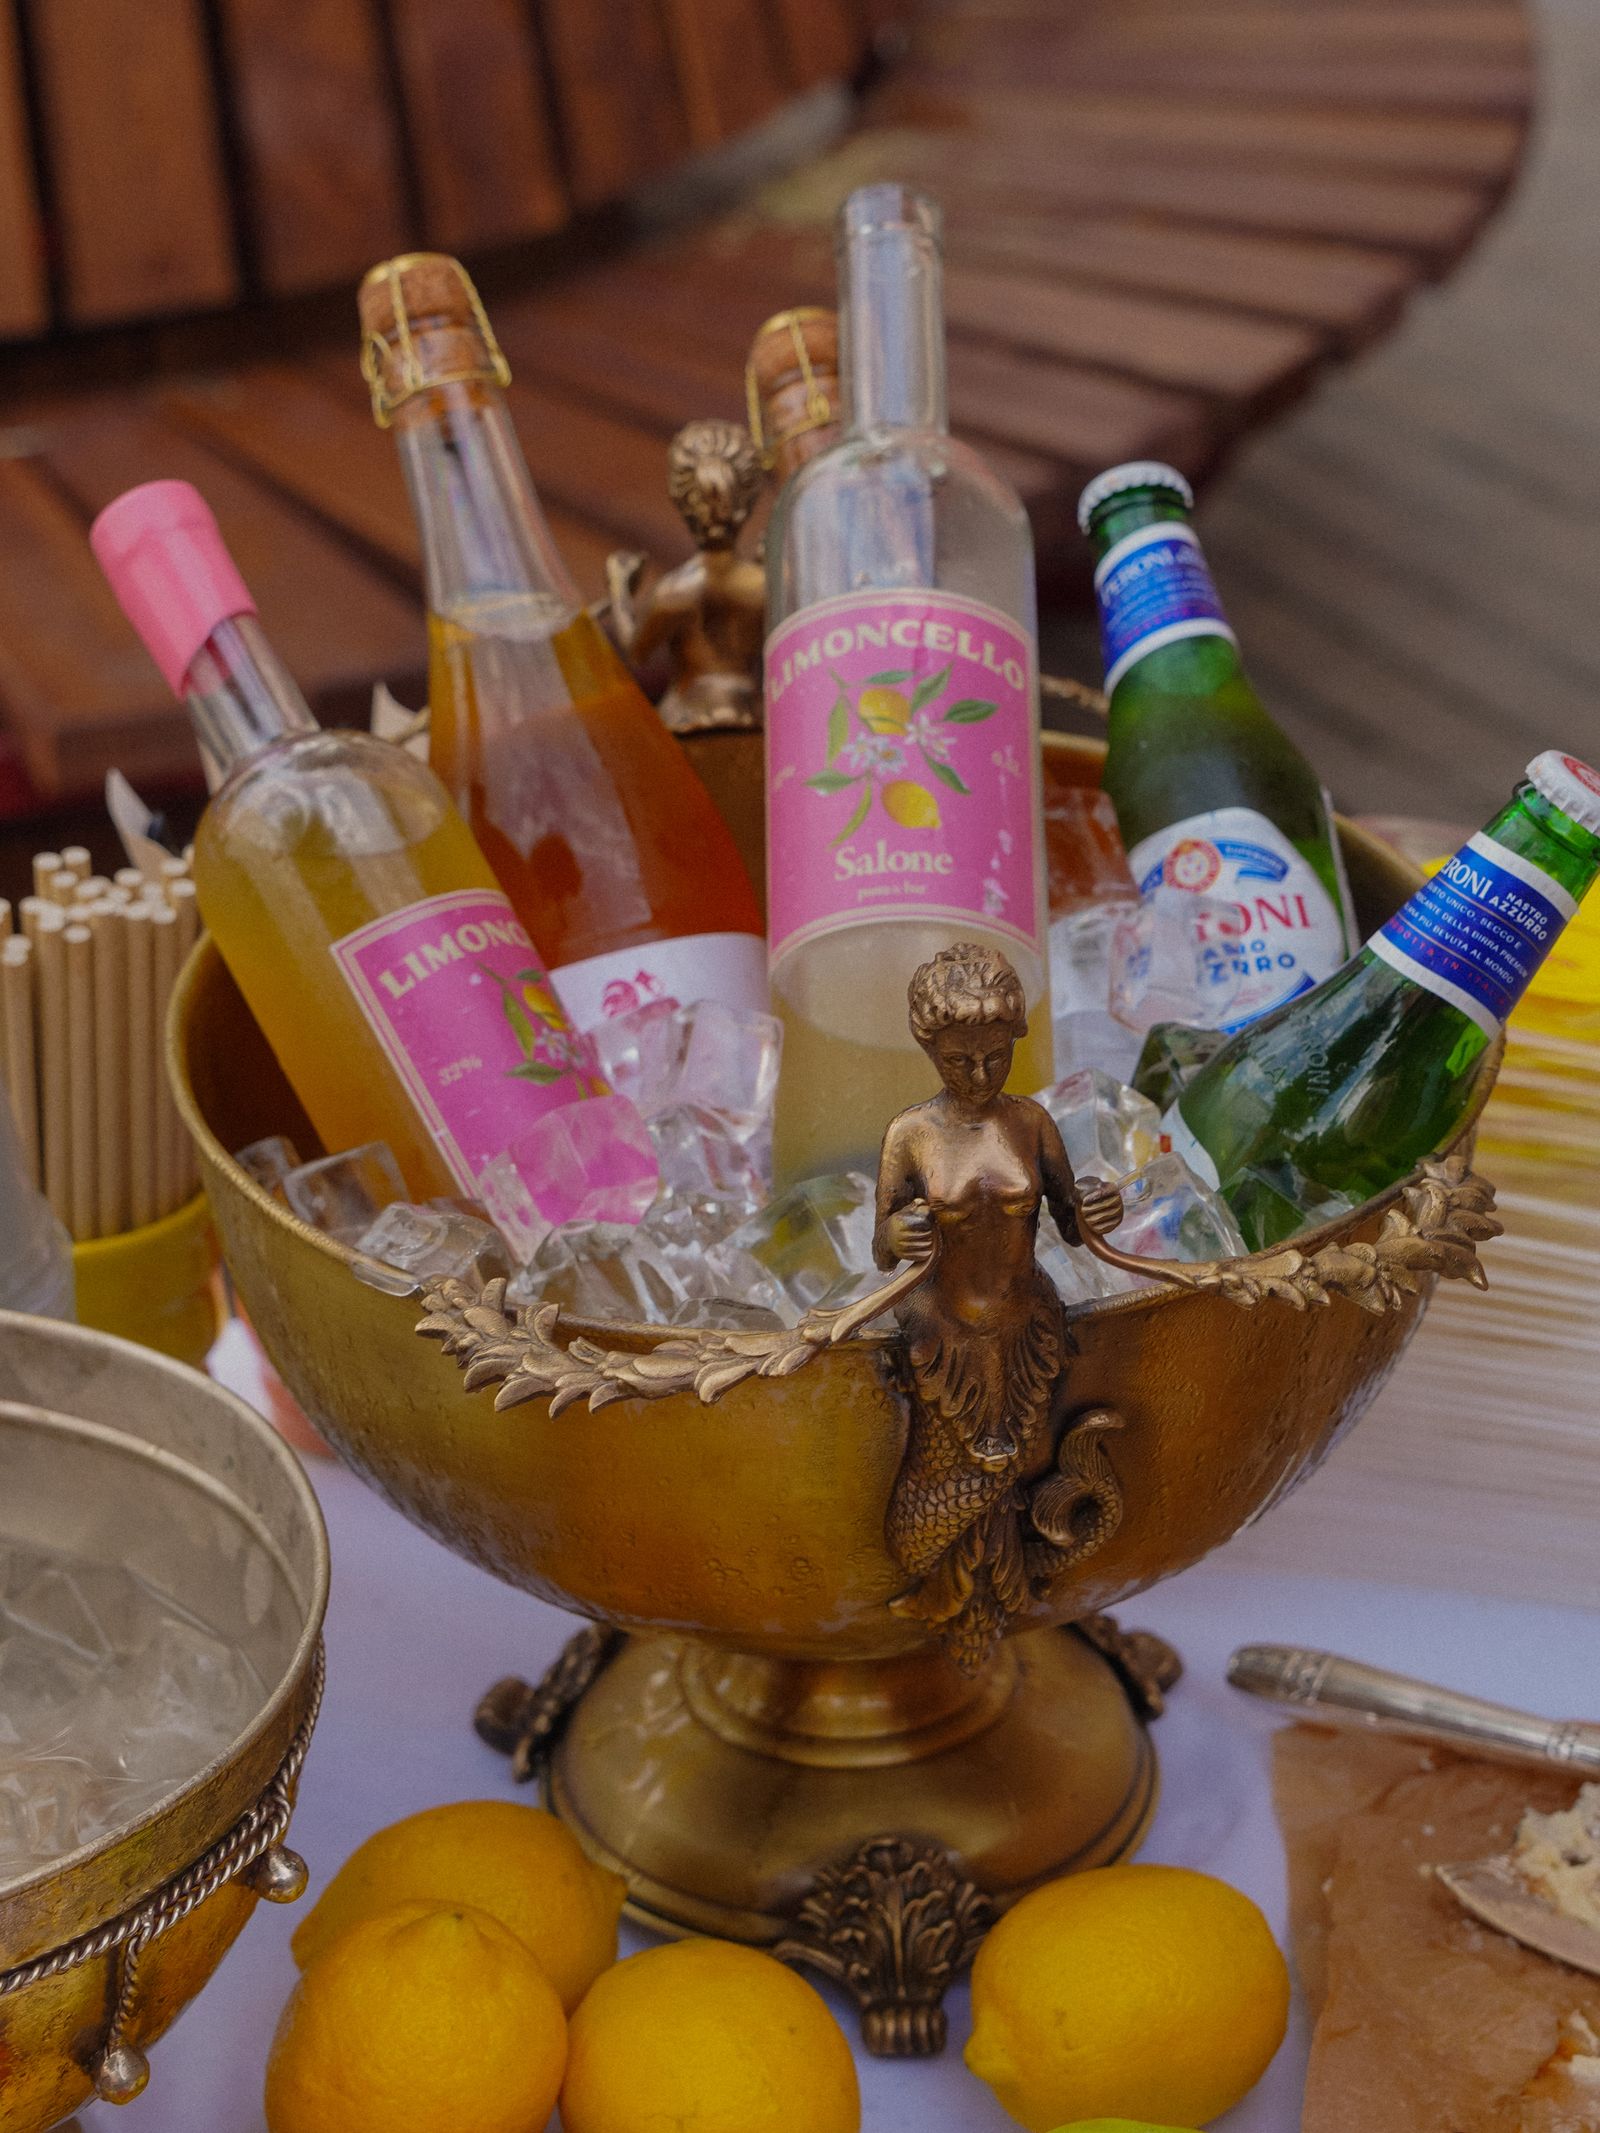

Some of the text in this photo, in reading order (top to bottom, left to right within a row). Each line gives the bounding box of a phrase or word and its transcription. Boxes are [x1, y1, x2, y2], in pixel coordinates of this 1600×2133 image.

[770, 620, 1024, 701] LIMONCELLO
[834, 839, 954, 880] Salone
[1442, 912, 1470, 934] DELLA
[1489, 895, 1548, 940] AZZURRO
[1506, 892, 1548, 925] NASTRO
[1433, 925, 1469, 952] BEVUTA
[1470, 949, 1482, 960] AL
[1484, 957, 1514, 984] MONDO
